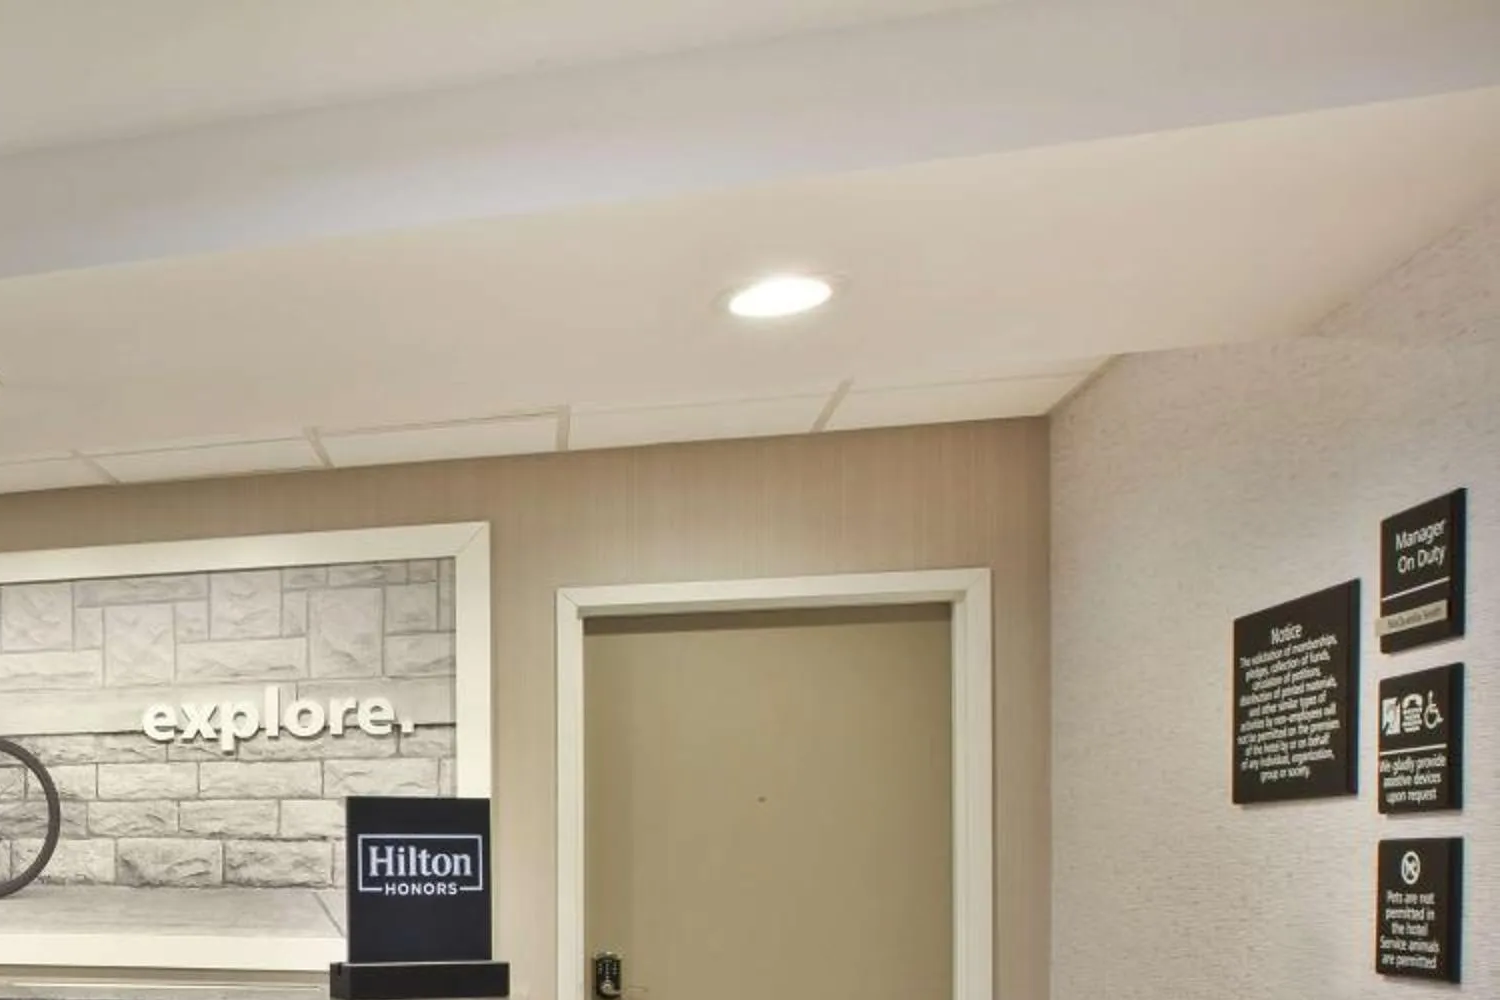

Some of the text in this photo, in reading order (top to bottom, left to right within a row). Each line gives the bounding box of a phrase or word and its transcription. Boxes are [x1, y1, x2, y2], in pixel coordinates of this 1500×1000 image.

[1395, 519, 1446, 551] Manager
[1398, 545, 1446, 573] On Duty
[1271, 624, 1302, 645] Notice
[142, 686, 415, 752] explore.
[1392, 756, 1414, 777] gladly
[1415, 753, 1447, 776] provide
[1414, 771, 1442, 785] devices
[1386, 788, 1437, 806] upon request
[368, 845, 473, 877] Hilton
[384, 882, 458, 896] HONORS
[1386, 890, 1435, 905] Pets are not
[1385, 907, 1435, 920] permitted in
[1391, 921, 1404, 935] the
[1380, 936, 1439, 953] Service animals
[1381, 953, 1437, 969] are permitted
